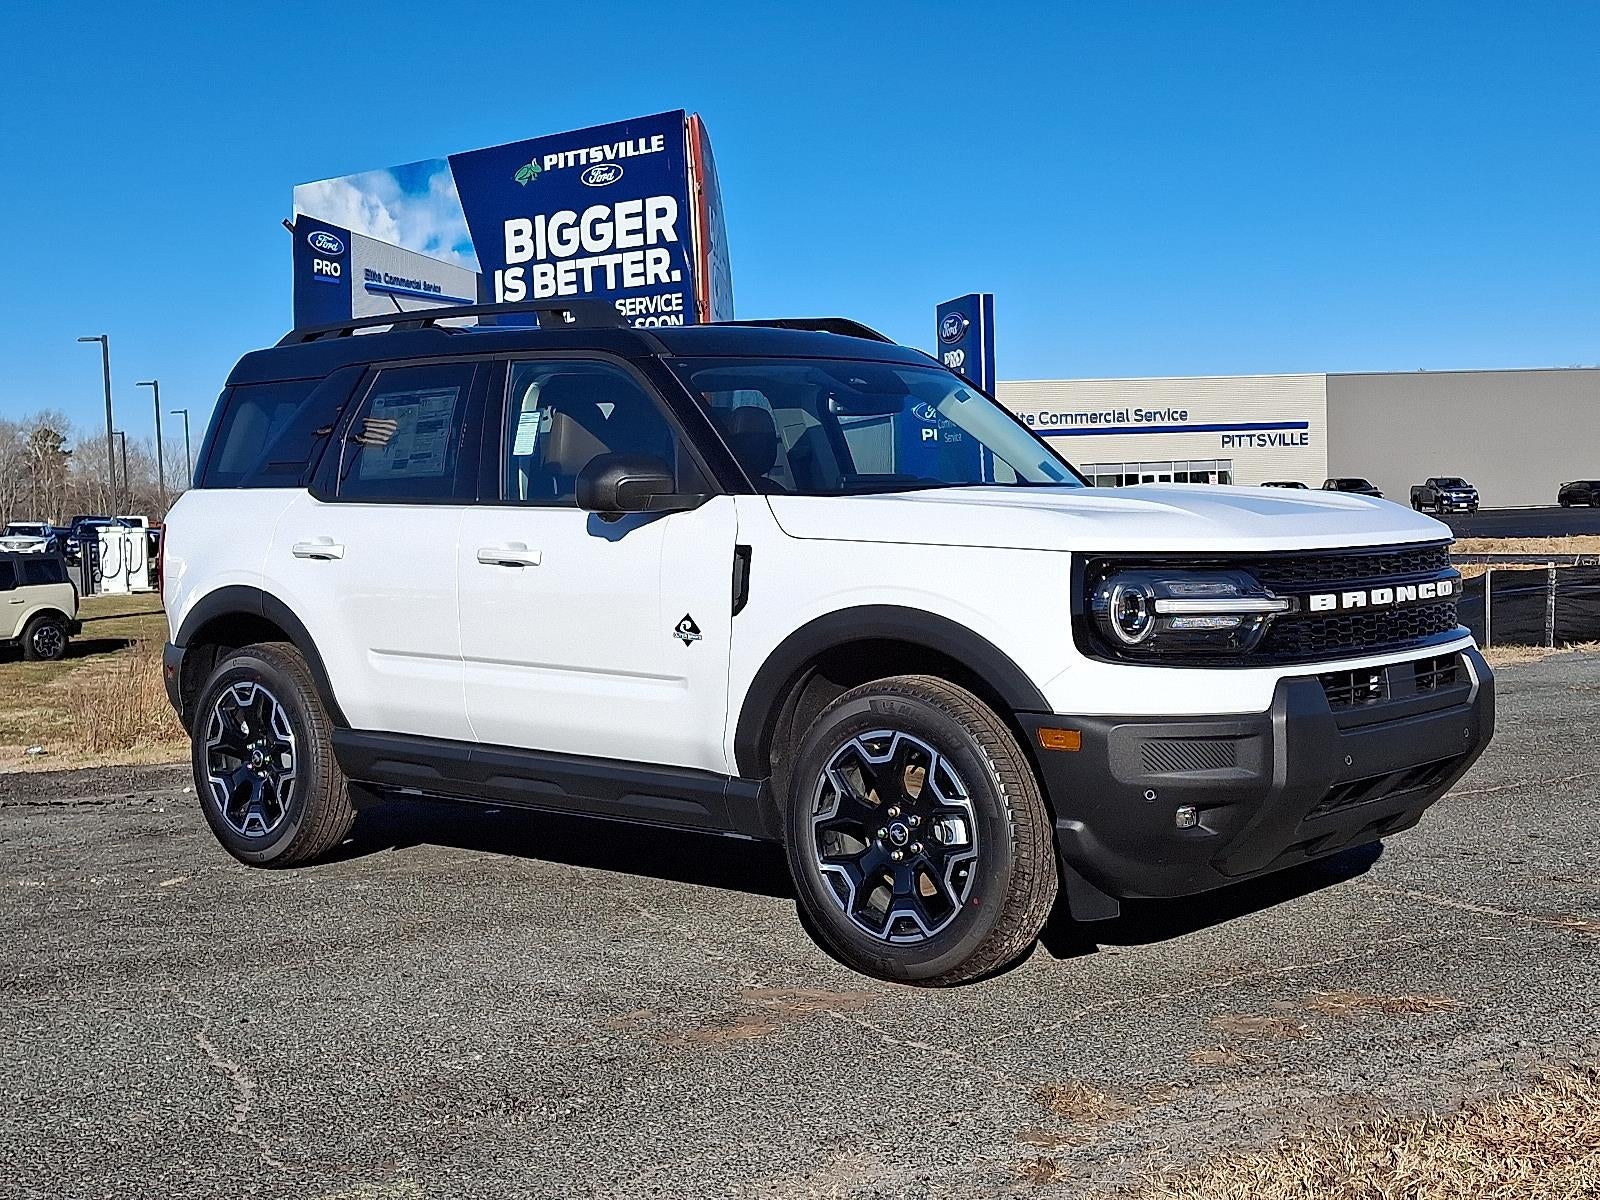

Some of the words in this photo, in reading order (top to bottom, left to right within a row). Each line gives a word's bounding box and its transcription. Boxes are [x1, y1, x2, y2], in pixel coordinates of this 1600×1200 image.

[543, 134, 665, 171] PITTSVILLE
[588, 166, 616, 184] Ford
[504, 195, 678, 265] BIGGER
[315, 235, 339, 252] Ford
[313, 258, 341, 277] PRO
[494, 266, 527, 303] IS
[533, 248, 682, 299] BETTER.
[383, 272, 422, 290] Commercial
[422, 280, 442, 293] Service
[615, 292, 684, 316] SERVICE
[942, 318, 958, 338] Ford
[943, 349, 965, 368] PRO
[1038, 408, 1130, 426] Commercial
[1133, 407, 1188, 423] Service
[1221, 432, 1309, 449] PITTSVILLE
[1309, 580, 1453, 612] BRONCO
